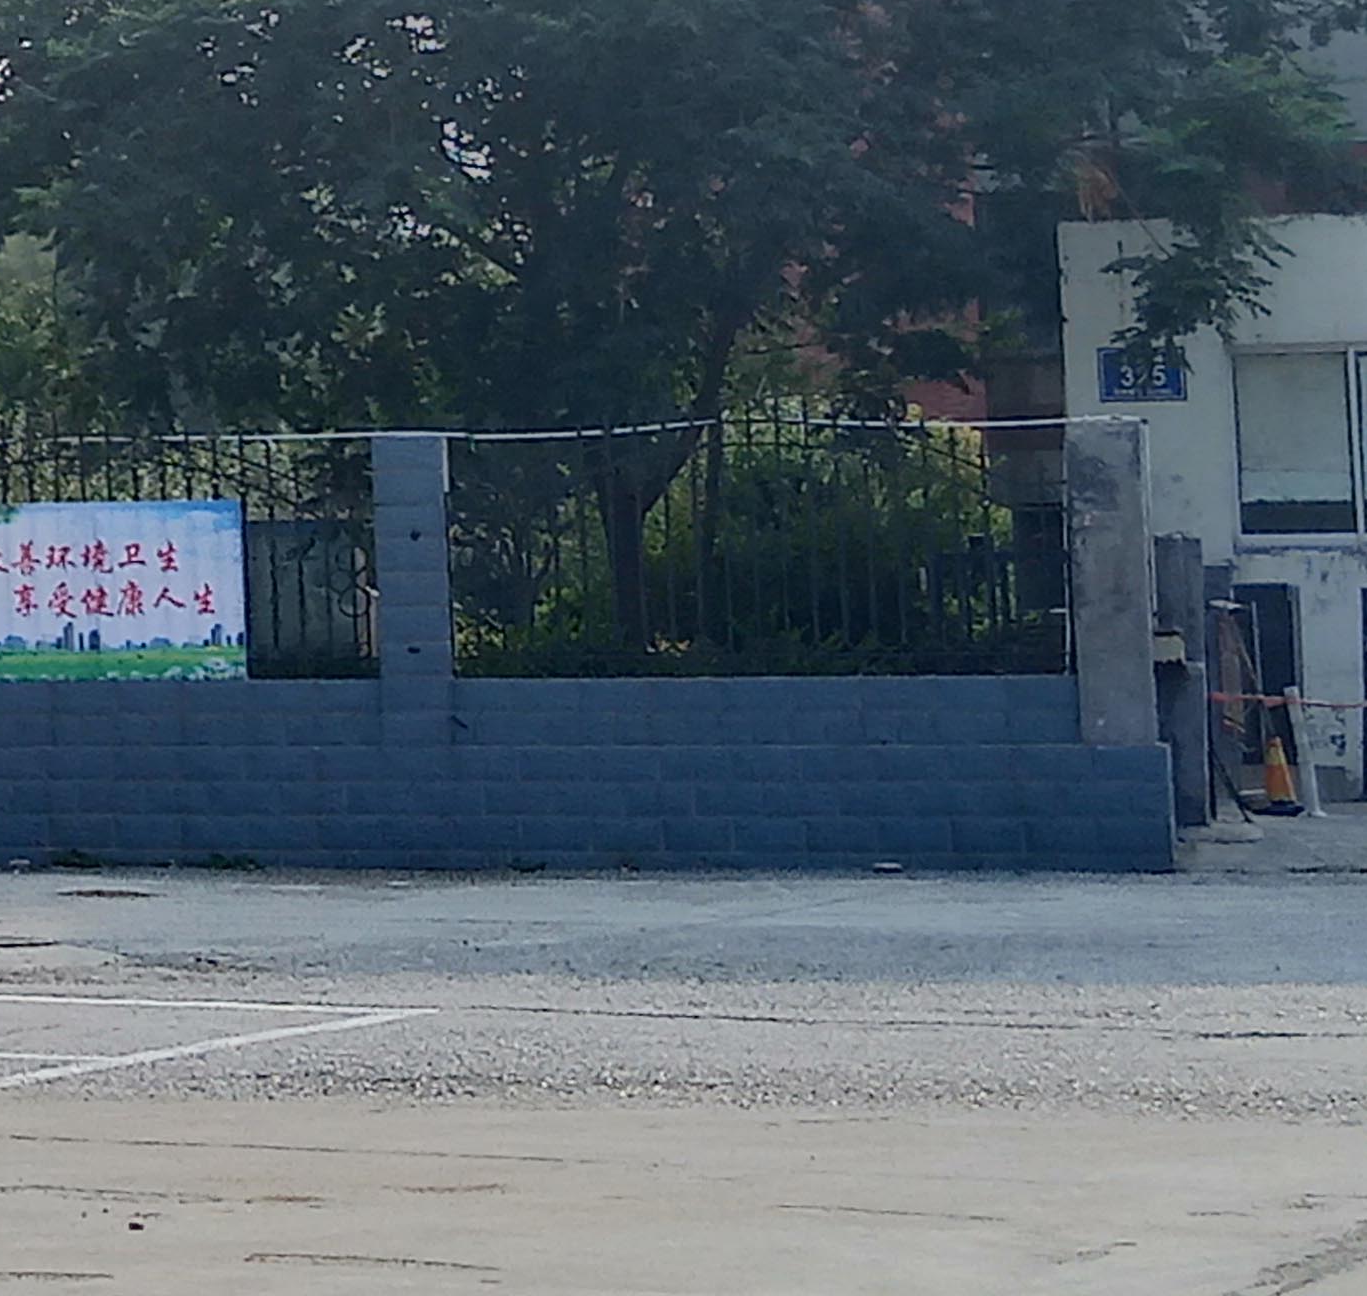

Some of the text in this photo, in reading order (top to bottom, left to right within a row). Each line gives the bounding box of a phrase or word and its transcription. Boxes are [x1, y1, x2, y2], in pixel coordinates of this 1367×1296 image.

[13, 580, 216, 619] 享受健康人生
